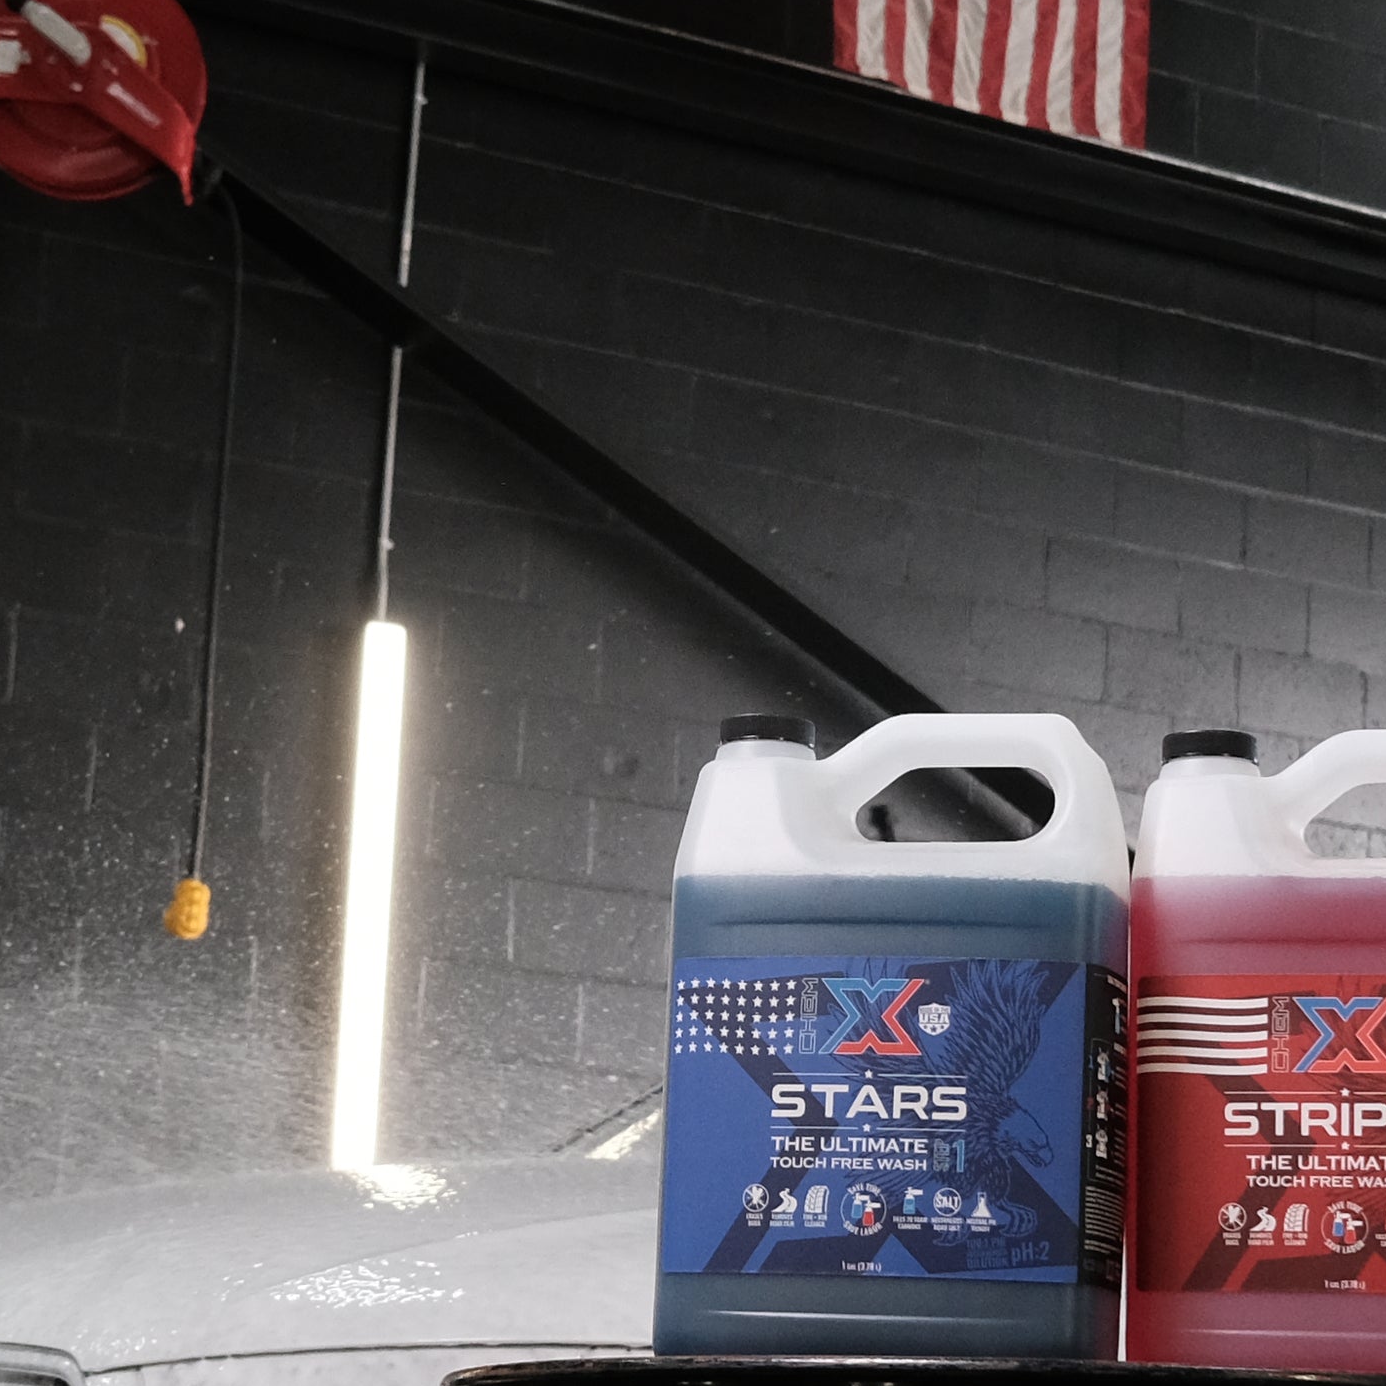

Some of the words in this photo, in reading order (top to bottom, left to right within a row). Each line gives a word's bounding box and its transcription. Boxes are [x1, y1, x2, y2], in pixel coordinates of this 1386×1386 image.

[799, 978, 818, 1054] CHEM
[919, 1013, 950, 1024] USA
[1272, 997, 1289, 1073] CHEM
[771, 1084, 967, 1121] STARS
[770, 1136, 815, 1152] THE
[820, 1138, 928, 1154] ULTIMATE
[770, 1156, 826, 1169] TOUCH
[830, 1157, 874, 1170] FREE
[877, 1158, 927, 1171] WASH
[952, 1139, 965, 1173] 1
[1246, 1154, 1292, 1170] THE
[1246, 1175, 1305, 1187] TOUCH
[1310, 1175, 1353, 1188] FREE
